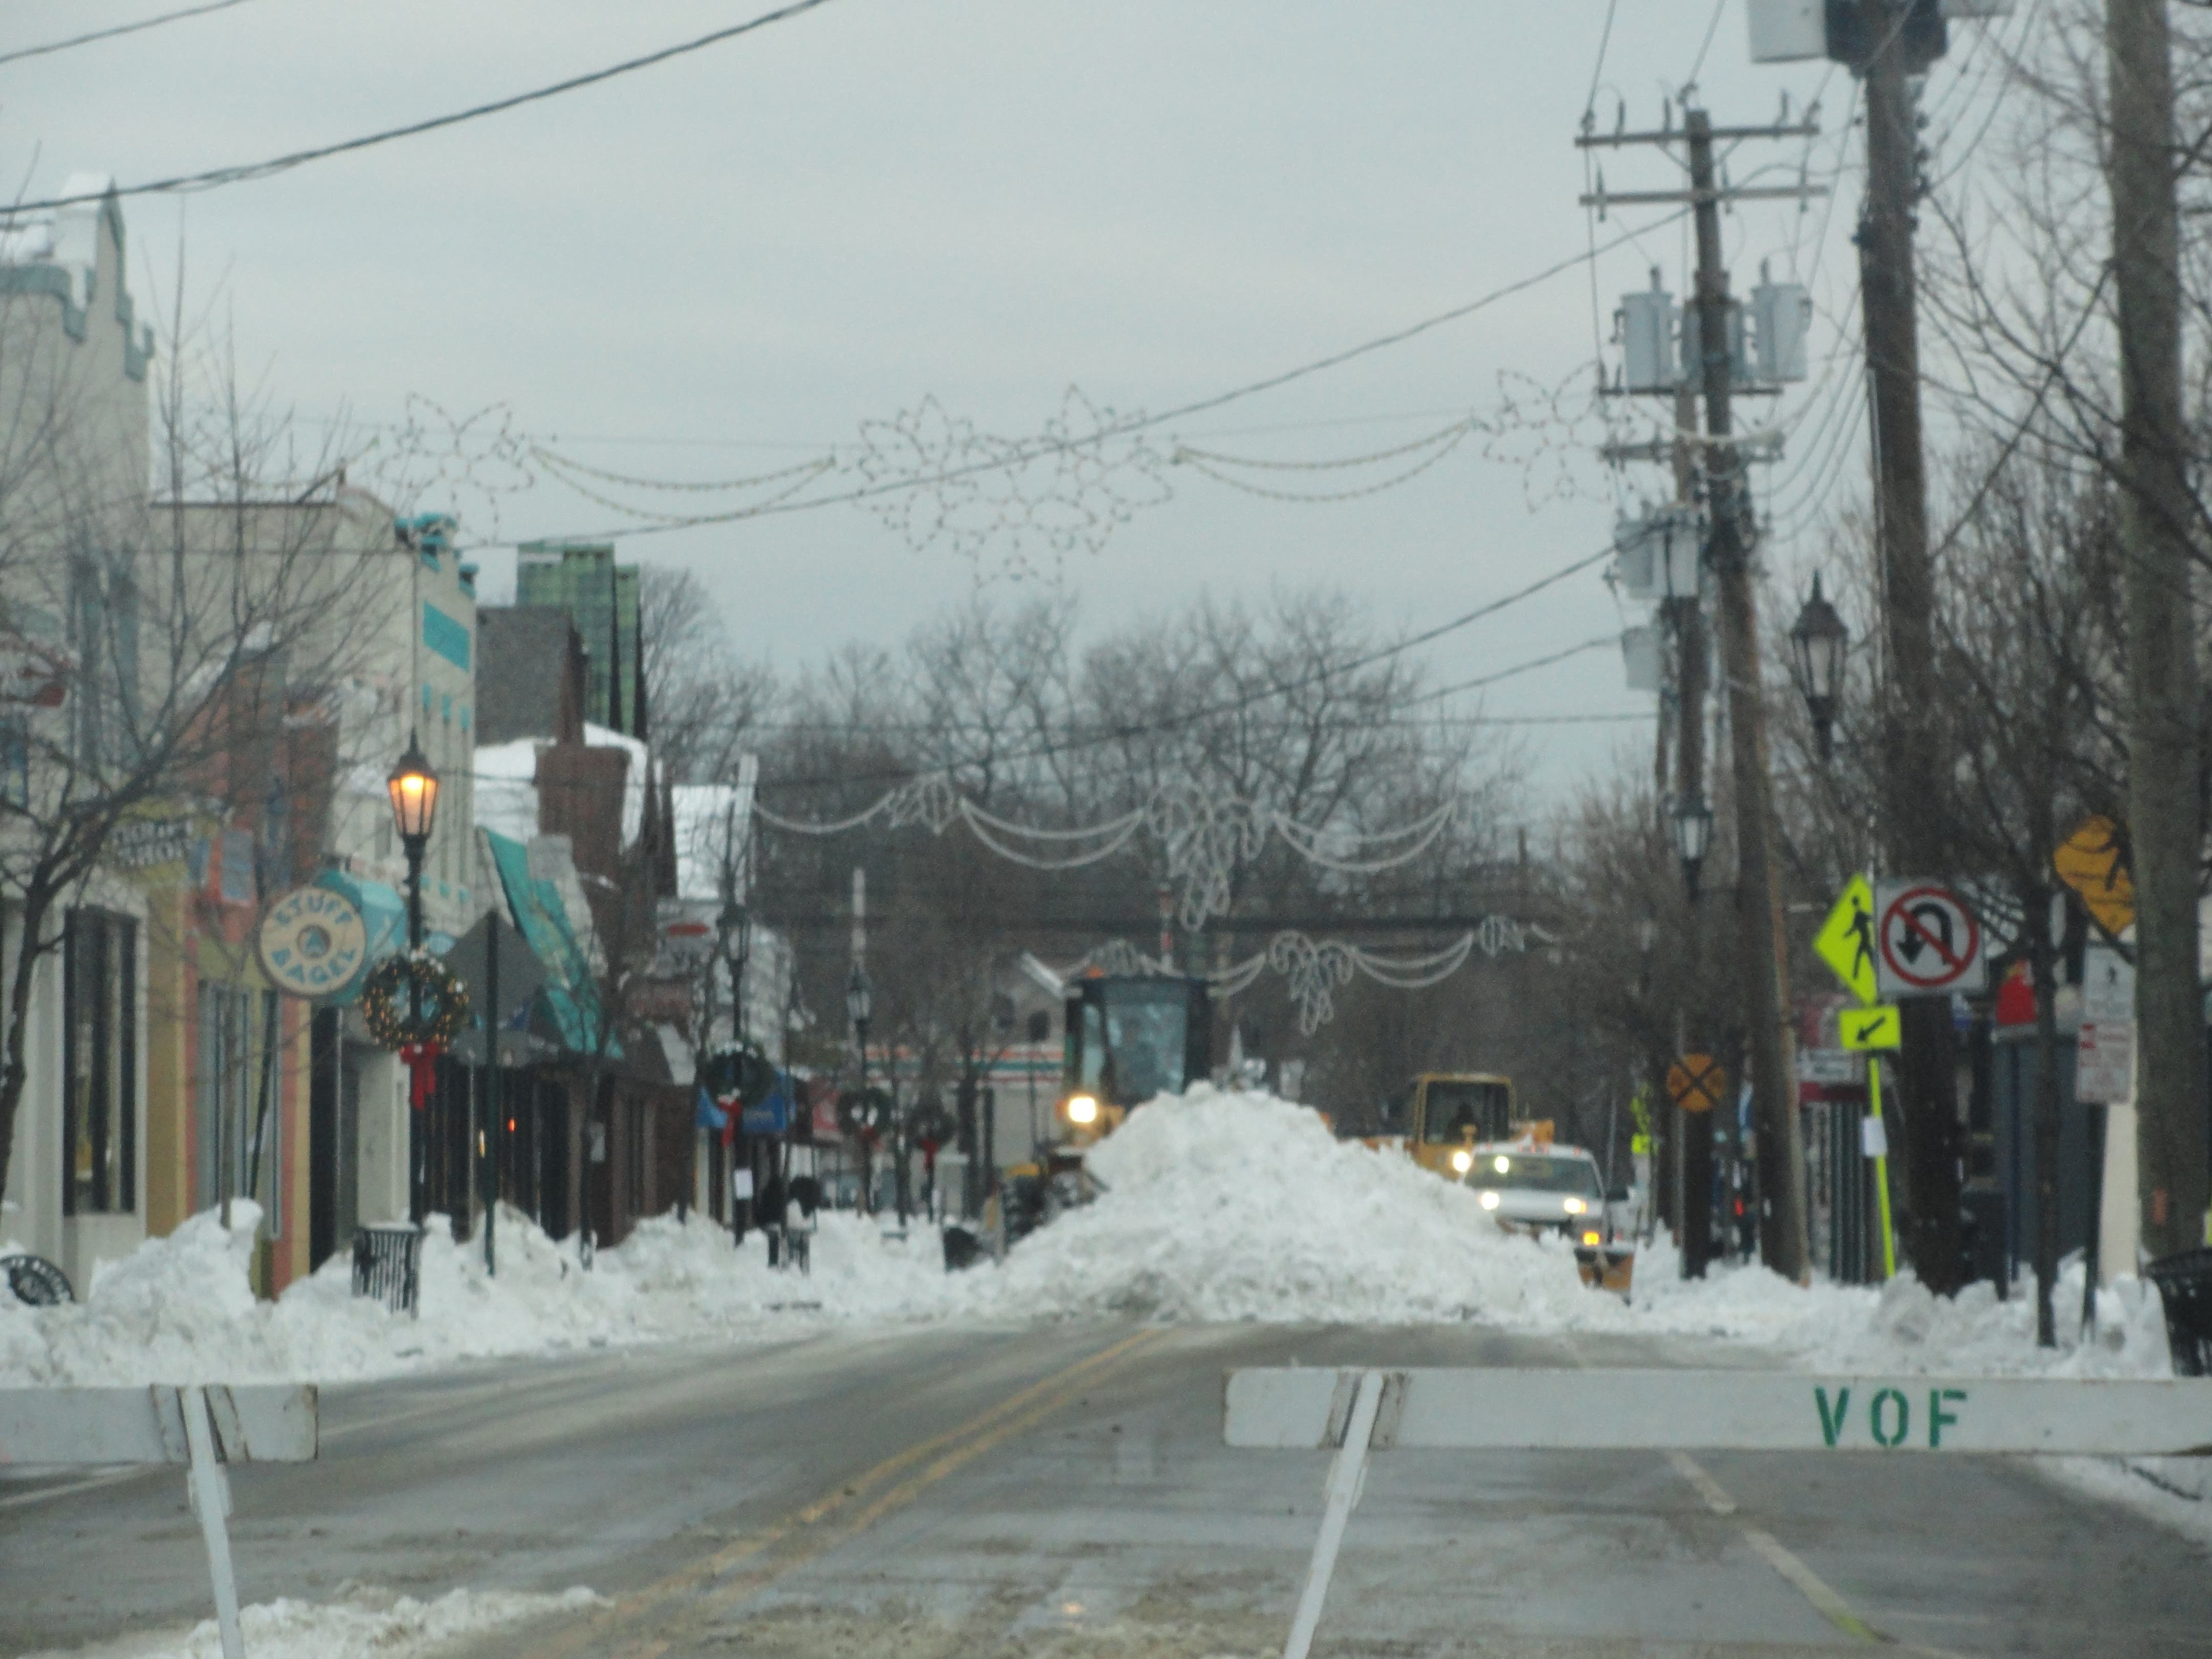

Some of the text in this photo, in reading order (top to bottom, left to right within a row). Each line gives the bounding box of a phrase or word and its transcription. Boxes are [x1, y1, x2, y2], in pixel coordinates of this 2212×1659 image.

[274, 895, 353, 927] STUFF
[271, 948, 356, 986] BAGEL
[1814, 1387, 1967, 1448] VOF
